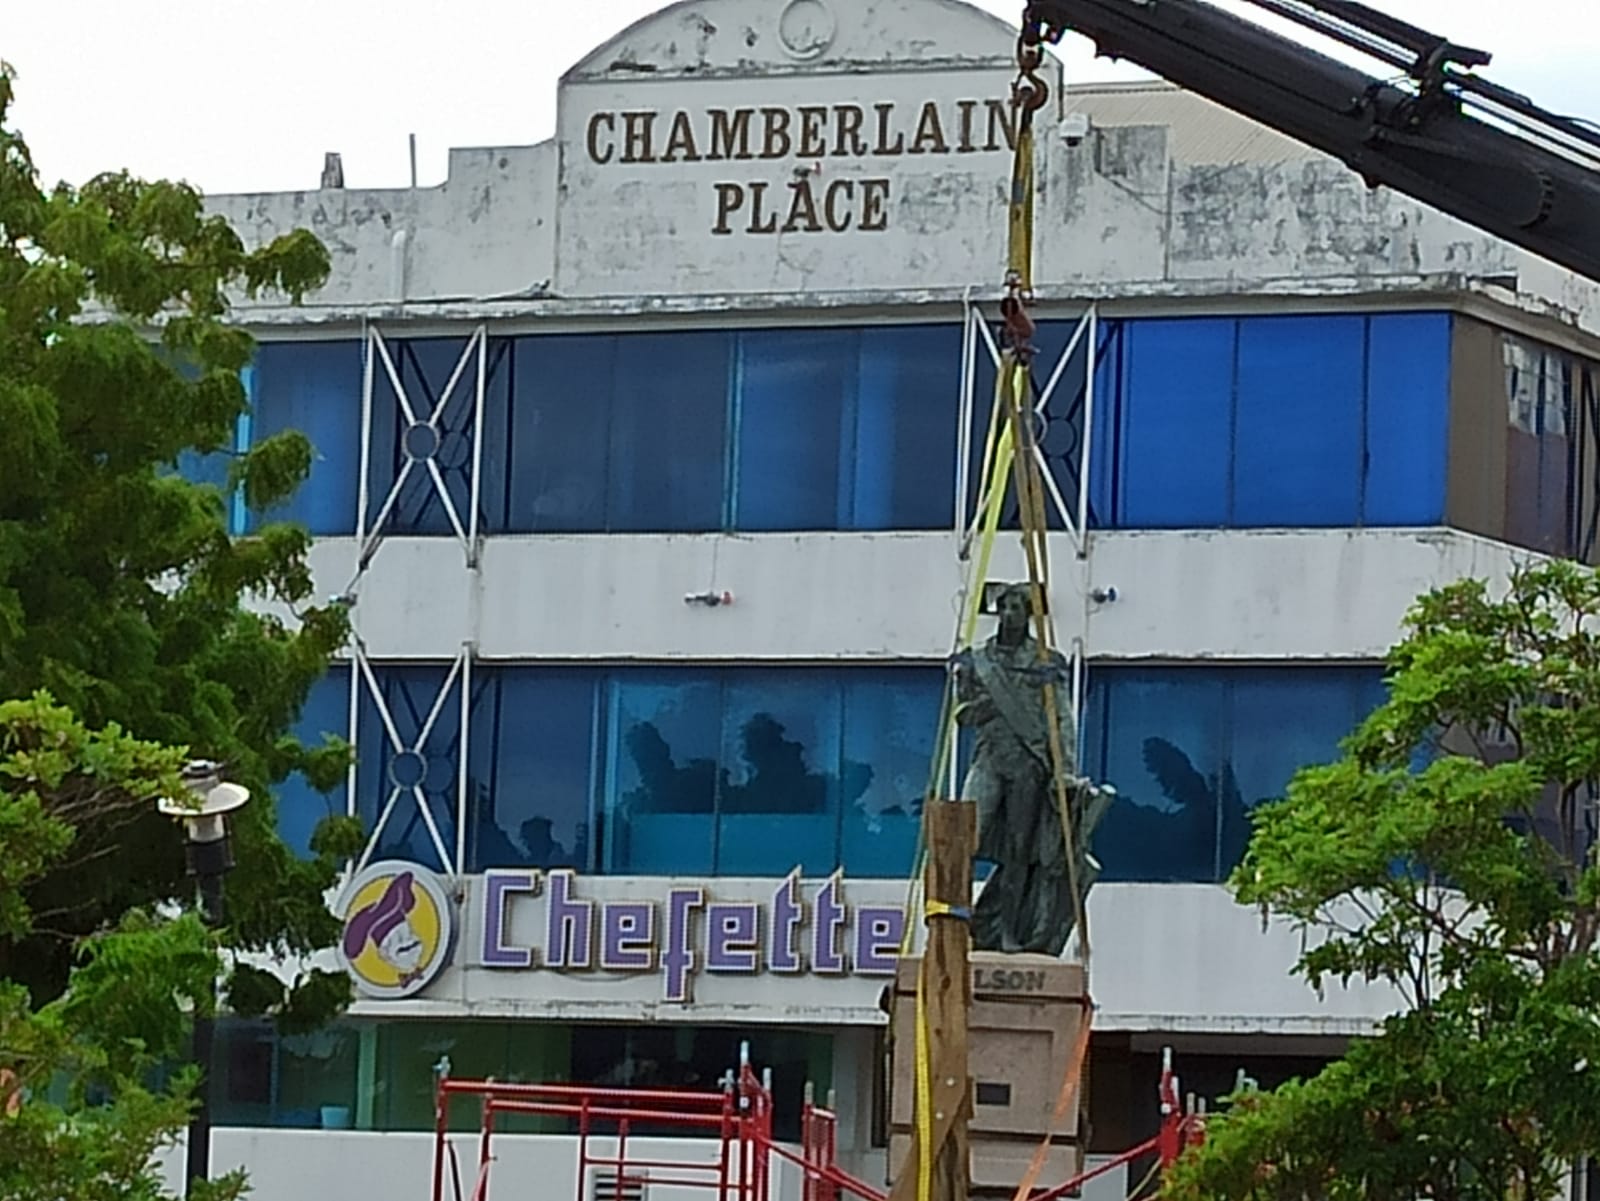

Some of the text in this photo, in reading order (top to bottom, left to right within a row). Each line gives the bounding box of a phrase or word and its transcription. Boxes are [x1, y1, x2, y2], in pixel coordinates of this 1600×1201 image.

[586, 99, 1017, 164] CHAMBERLAIN
[711, 178, 890, 234] PLACE
[480, 864, 904, 1001] Chefette
[973, 968, 1046, 992] LSON
